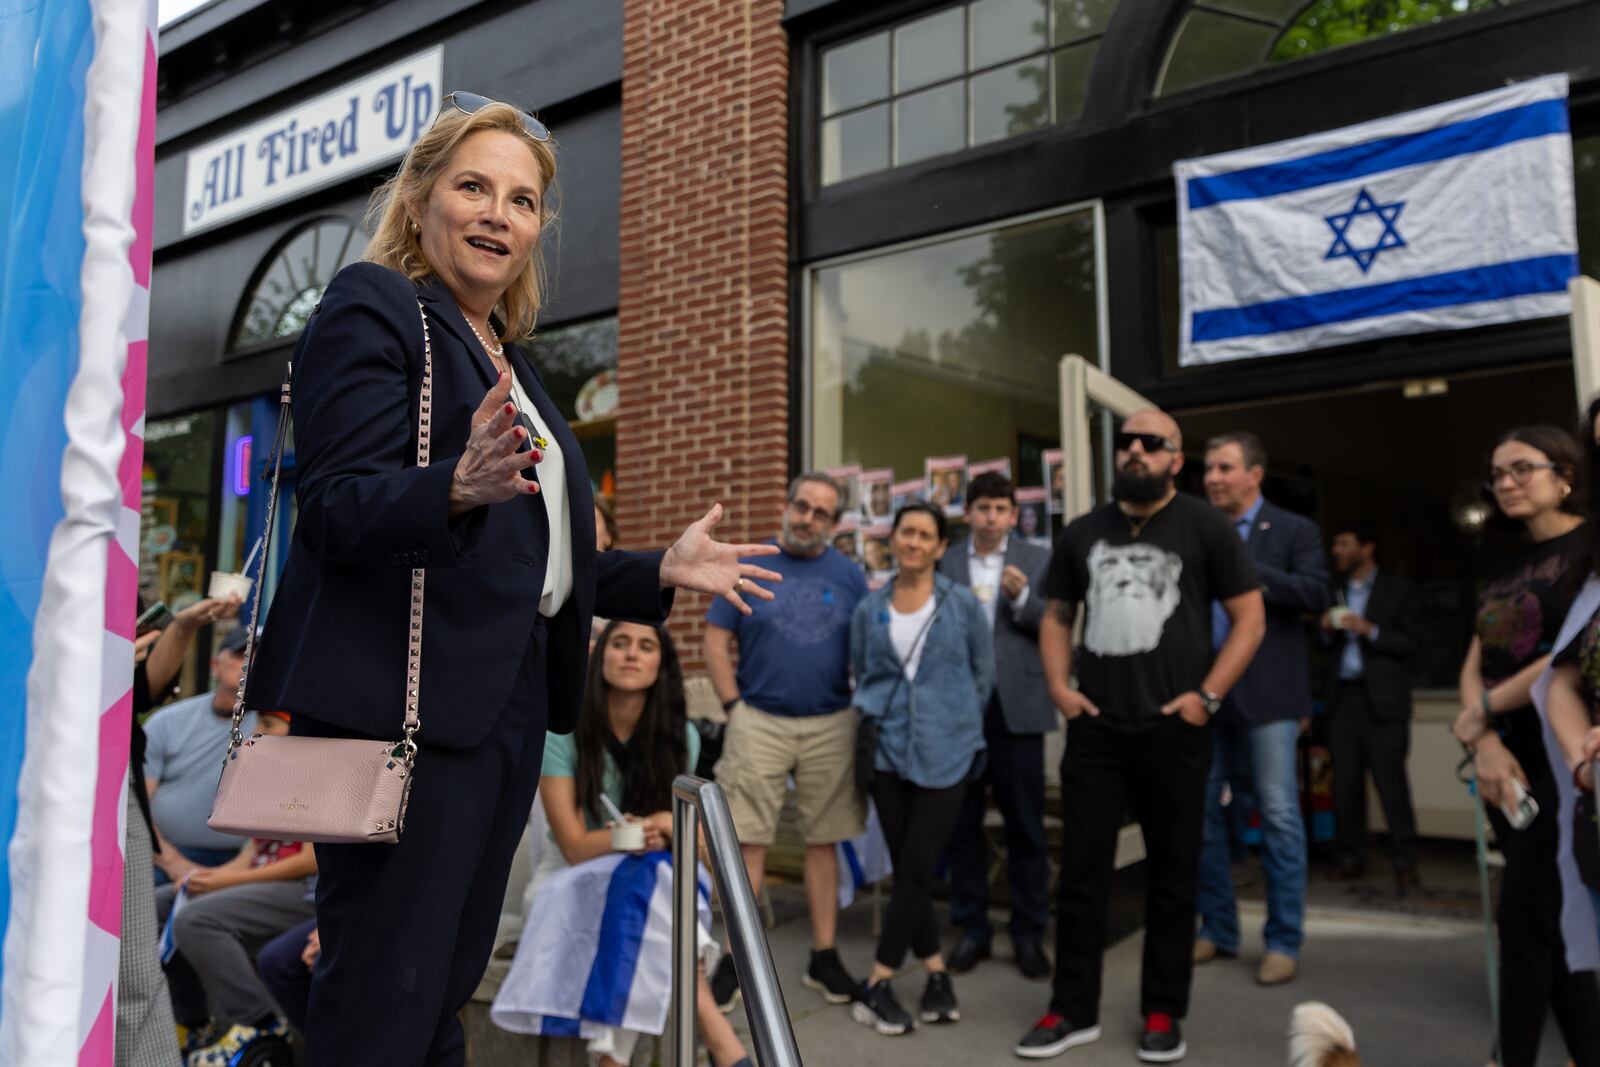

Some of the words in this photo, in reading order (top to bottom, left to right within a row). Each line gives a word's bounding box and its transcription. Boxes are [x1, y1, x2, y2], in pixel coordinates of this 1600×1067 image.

[191, 143, 246, 221] All
[257, 96, 361, 186] Fired
[373, 74, 433, 145] Up
